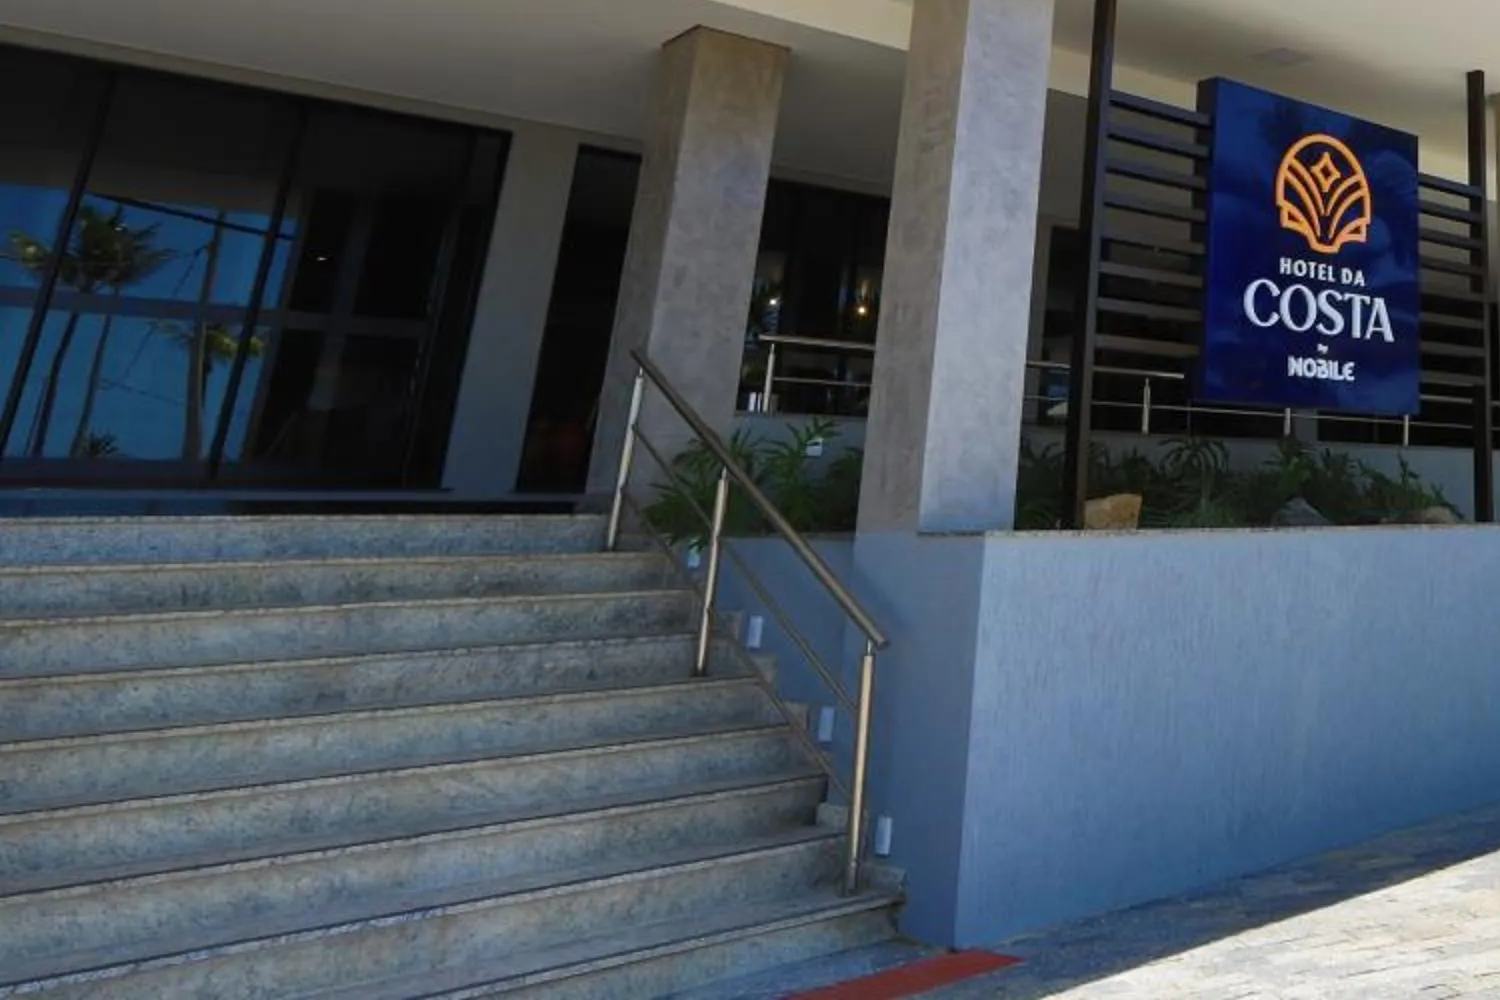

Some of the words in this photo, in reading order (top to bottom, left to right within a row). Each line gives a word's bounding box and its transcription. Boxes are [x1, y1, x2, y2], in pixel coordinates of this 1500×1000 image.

[1279, 257, 1336, 283] HOTEL
[1341, 267, 1366, 287] DA
[1243, 278, 1395, 342] COSTA
[1288, 356, 1355, 381] NOBILE
